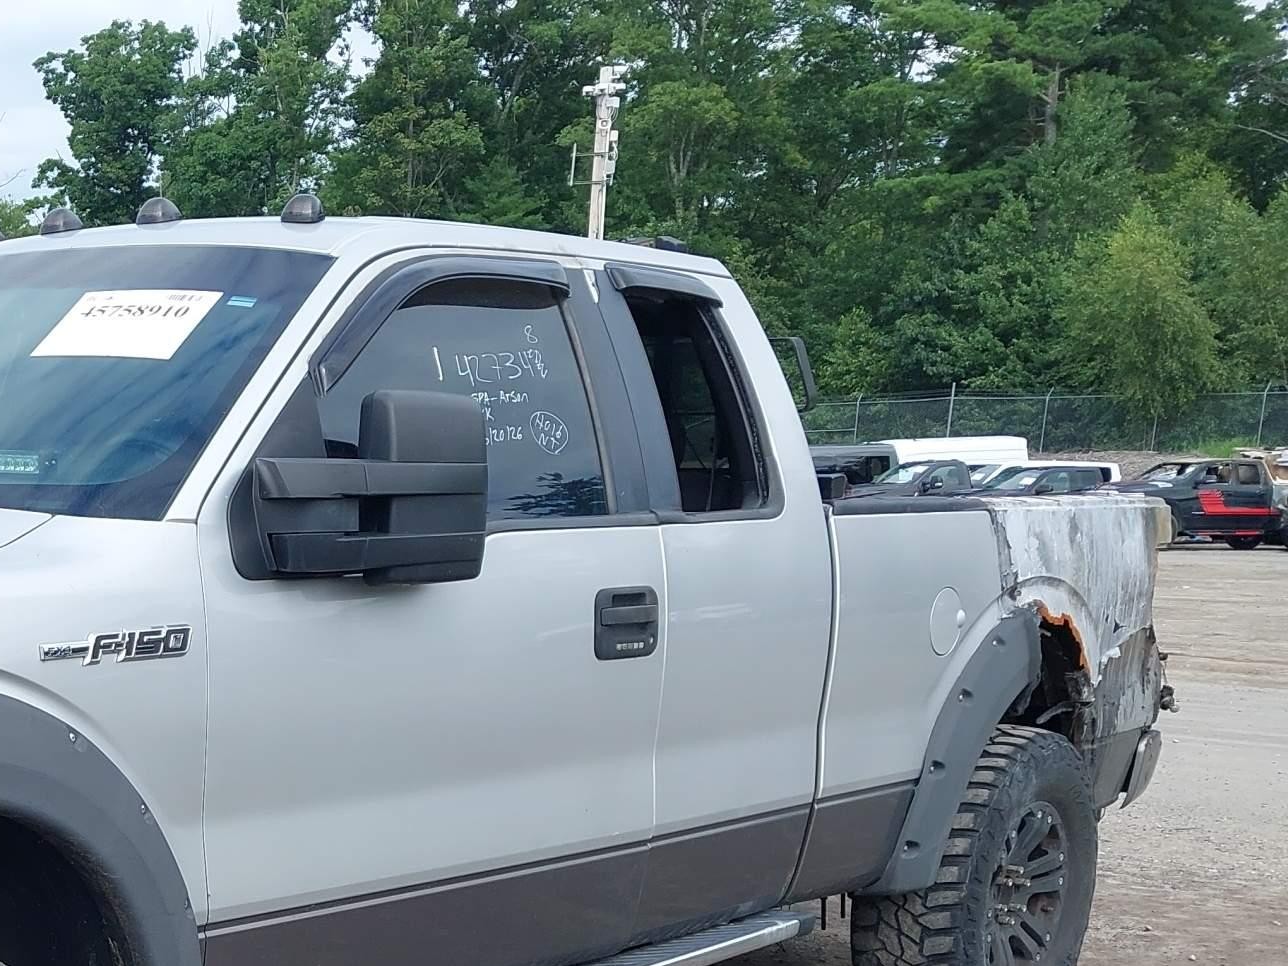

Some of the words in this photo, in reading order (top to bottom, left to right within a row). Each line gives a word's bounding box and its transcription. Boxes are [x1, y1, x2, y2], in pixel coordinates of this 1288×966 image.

[80, 304, 192, 319] 45758910
[524, 324, 538, 344] 8
[482, 407, 495, 421] K
